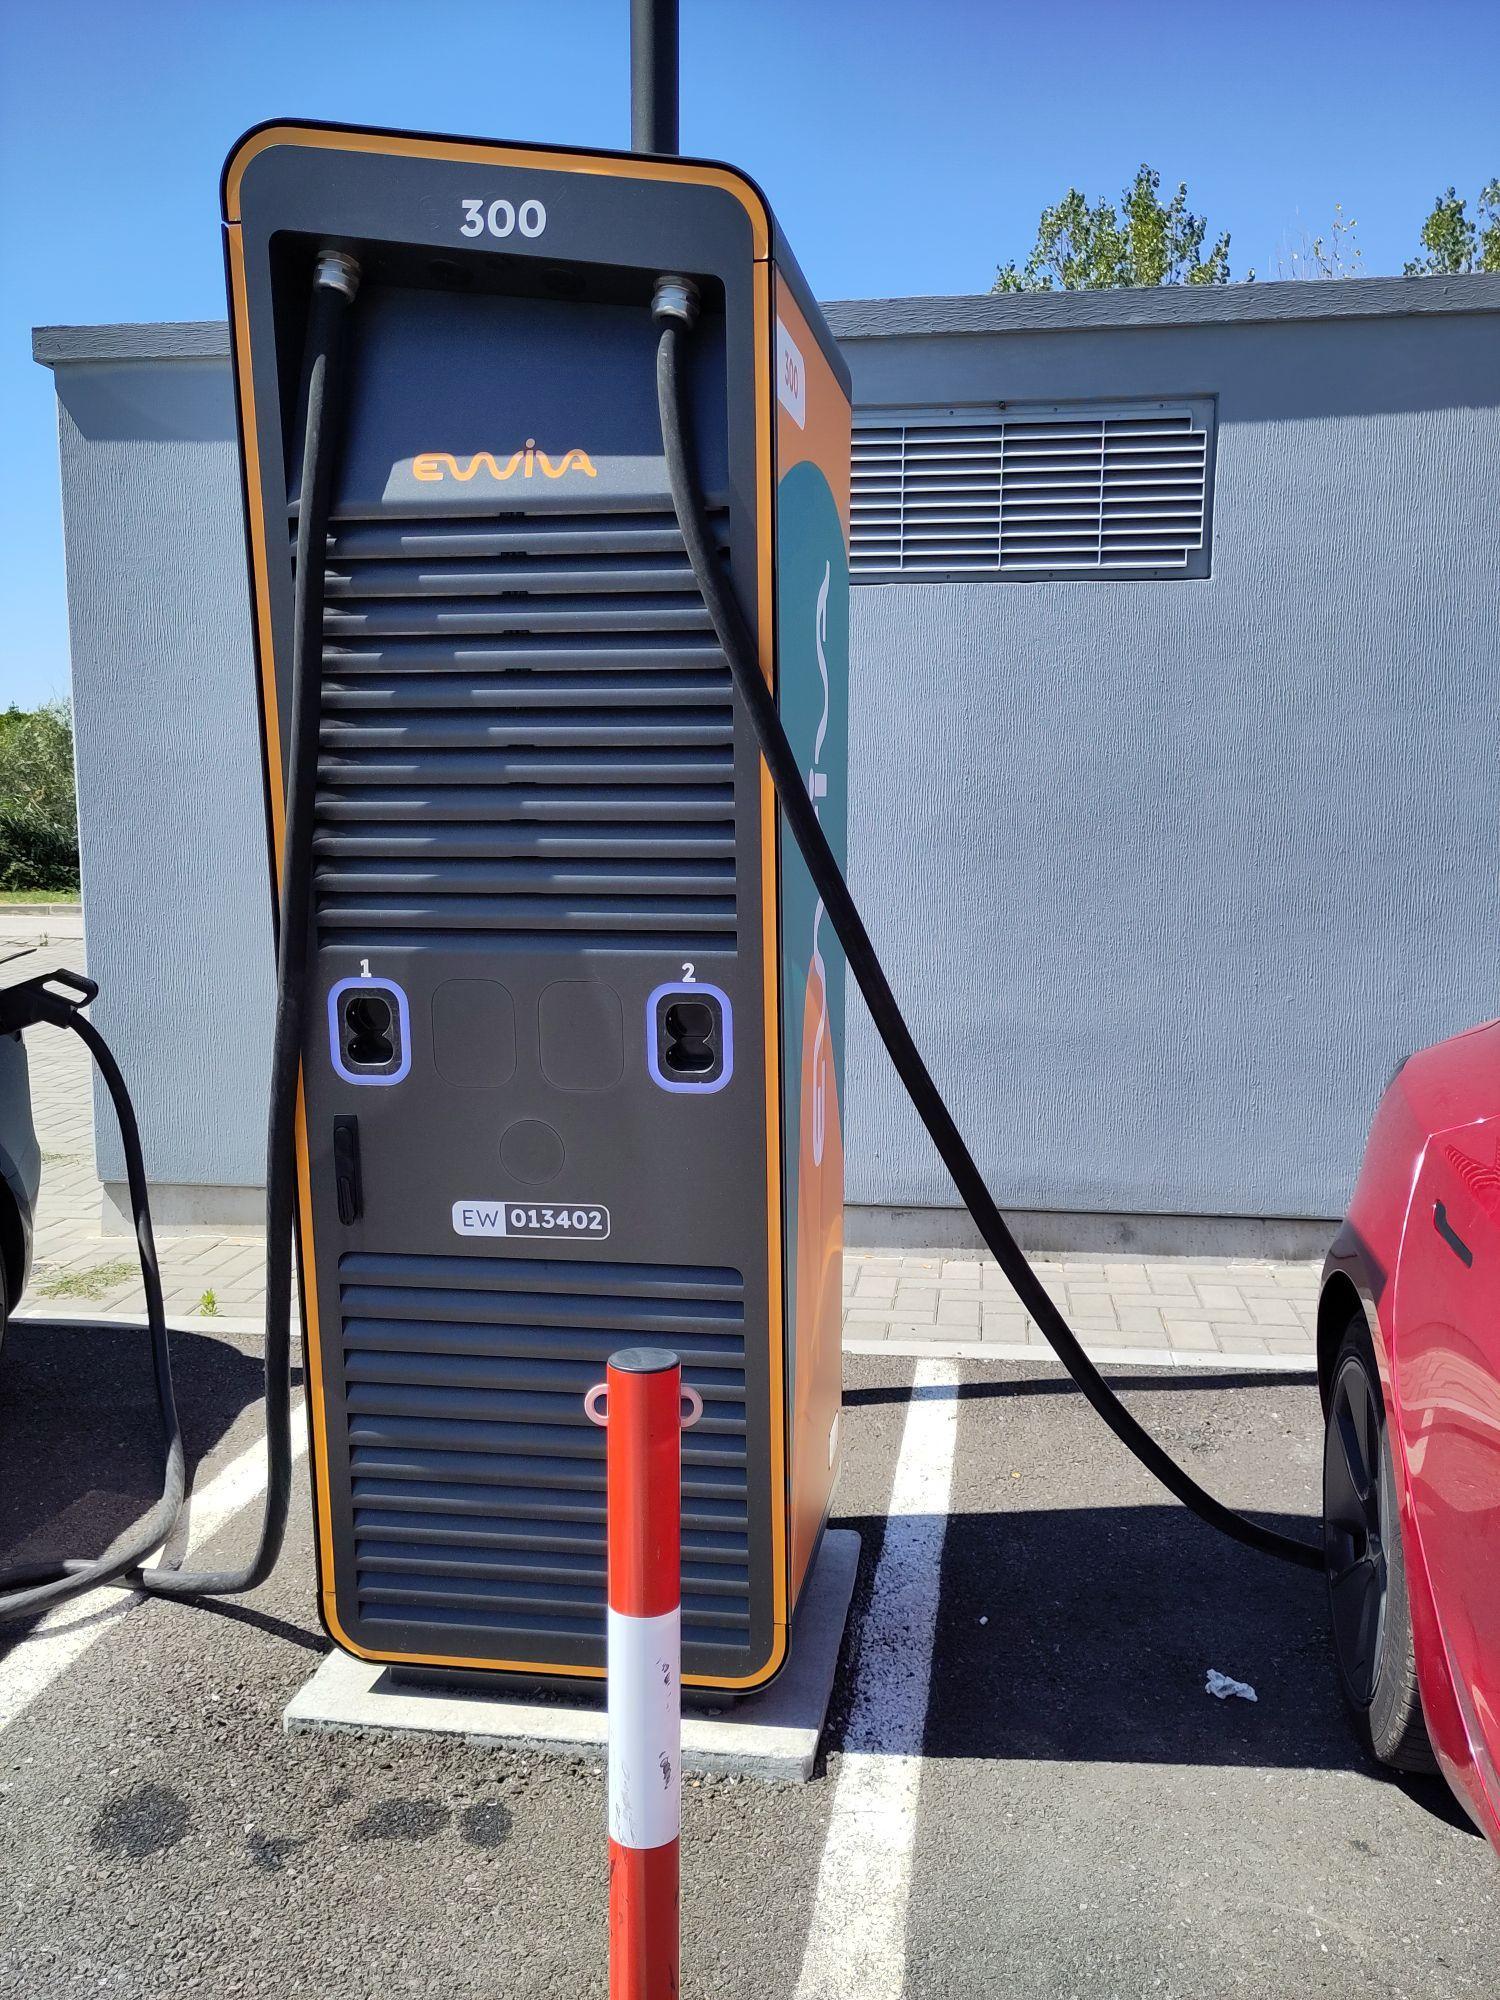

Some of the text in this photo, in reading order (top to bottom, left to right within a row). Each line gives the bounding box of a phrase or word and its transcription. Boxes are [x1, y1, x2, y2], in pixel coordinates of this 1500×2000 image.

[460, 200, 547, 238] 300
[784, 350, 799, 400] 300
[360, 958, 372, 978] 1
[681, 963, 697, 983] 2
[462, 1208, 603, 1230] EW 013402
